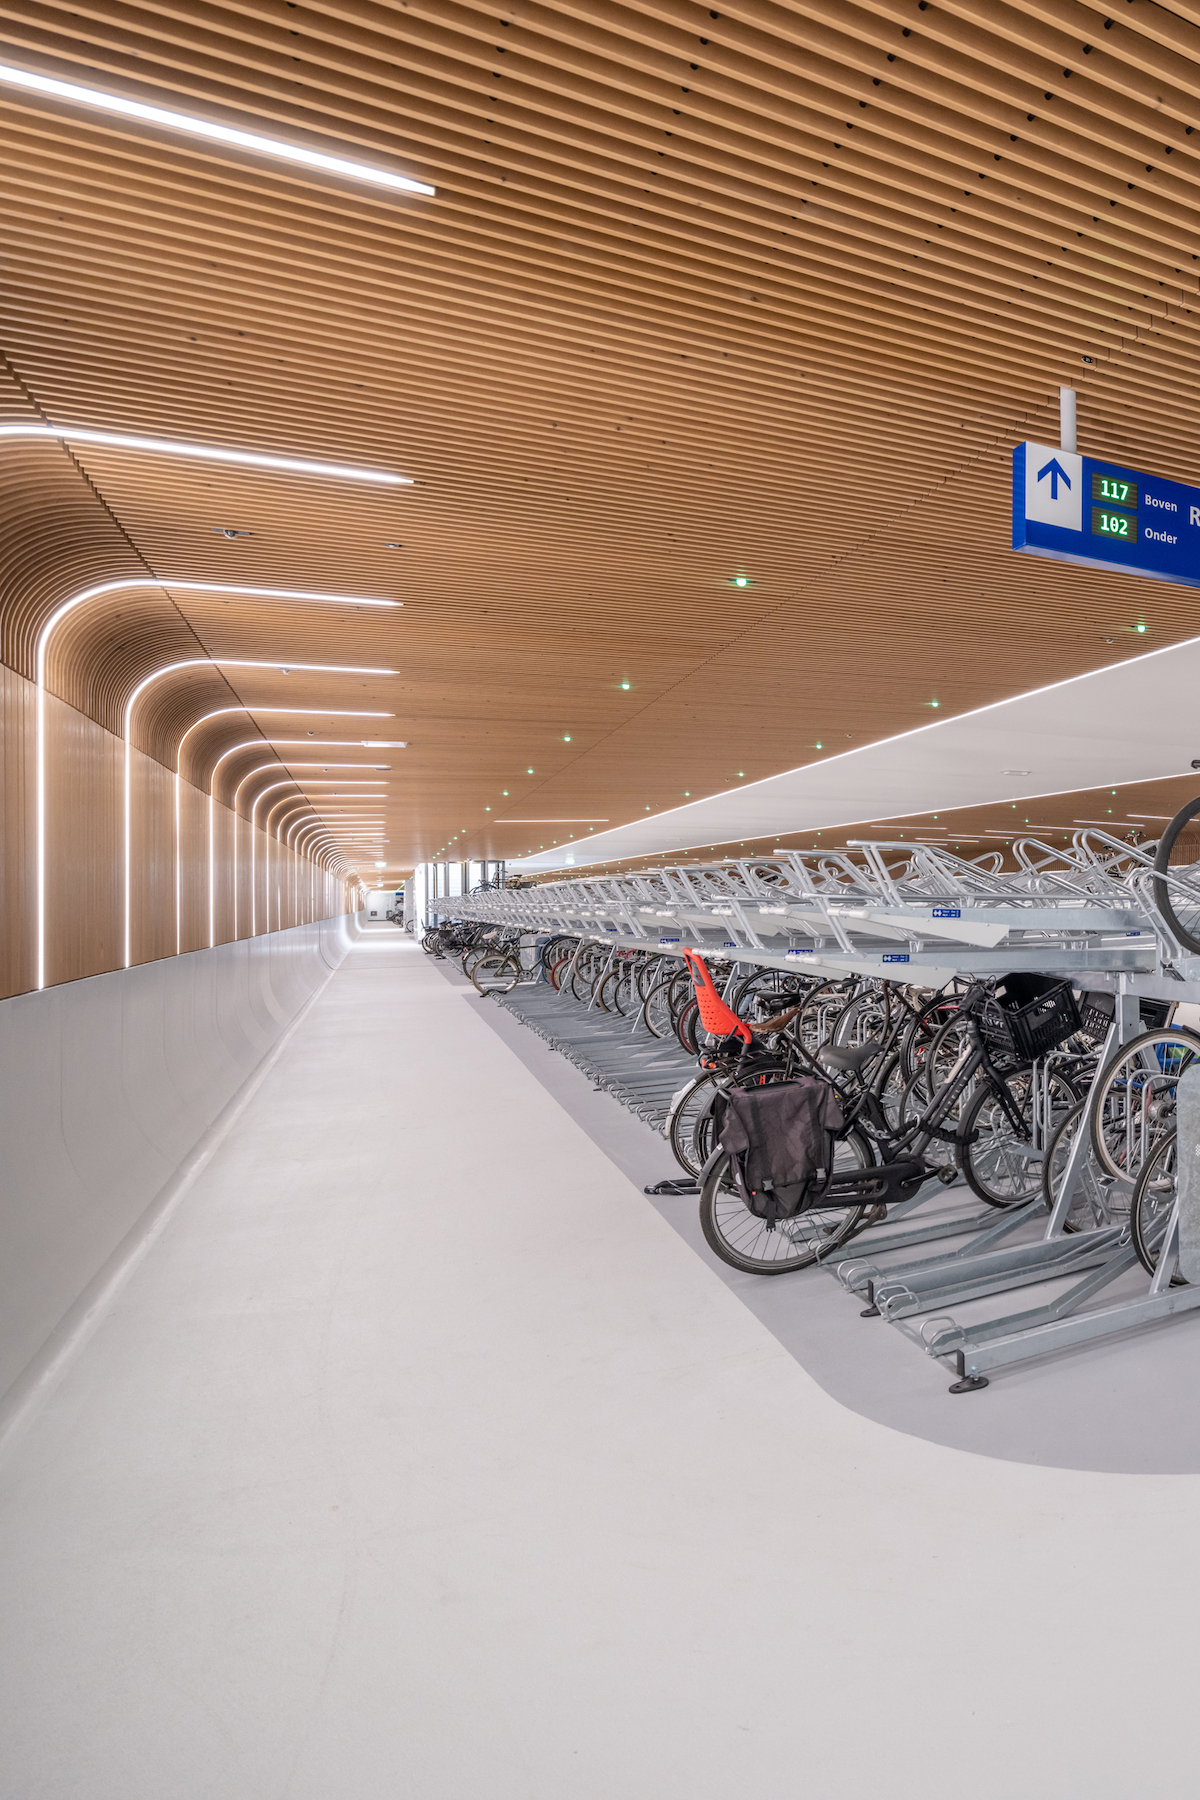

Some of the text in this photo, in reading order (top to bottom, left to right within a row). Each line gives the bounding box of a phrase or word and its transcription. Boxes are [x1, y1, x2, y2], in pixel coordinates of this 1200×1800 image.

[1101, 480, 1129, 501] 117
[1145, 494, 1178, 512] Boven
[1100, 514, 1128, 536] 102
[1145, 528, 1178, 544] Onder
